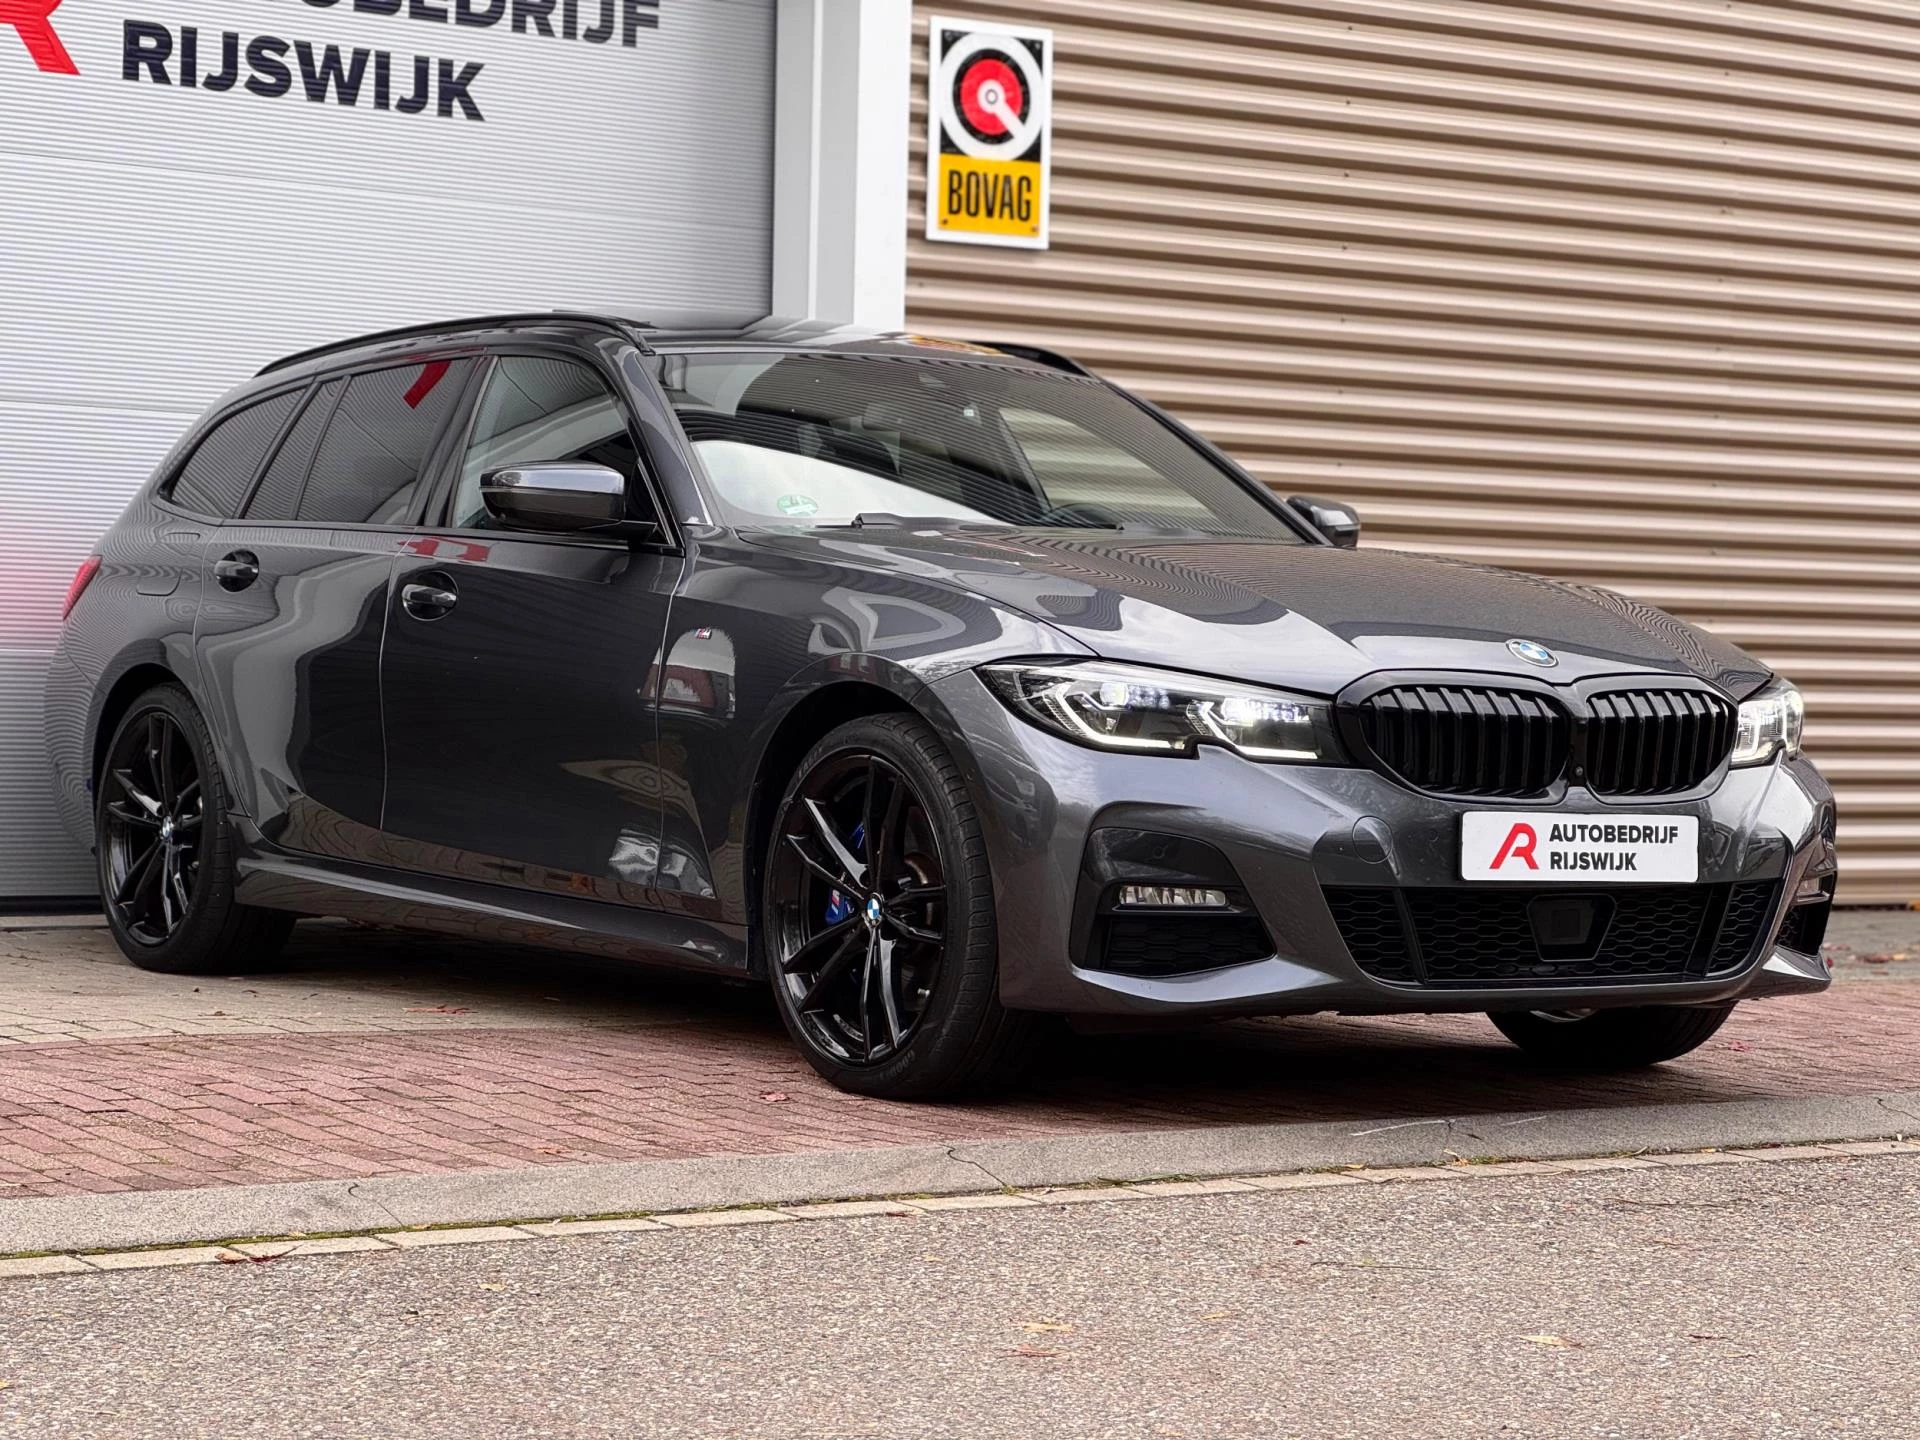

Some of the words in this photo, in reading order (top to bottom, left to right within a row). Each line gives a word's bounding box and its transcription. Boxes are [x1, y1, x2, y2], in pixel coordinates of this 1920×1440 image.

[122, 19, 486, 122] RIJSWIJK
[948, 169, 1031, 222] BOVAG
[1549, 823, 1679, 844] AUTOBEDRIJF
[1550, 851, 1637, 871] RIJSWIJK
